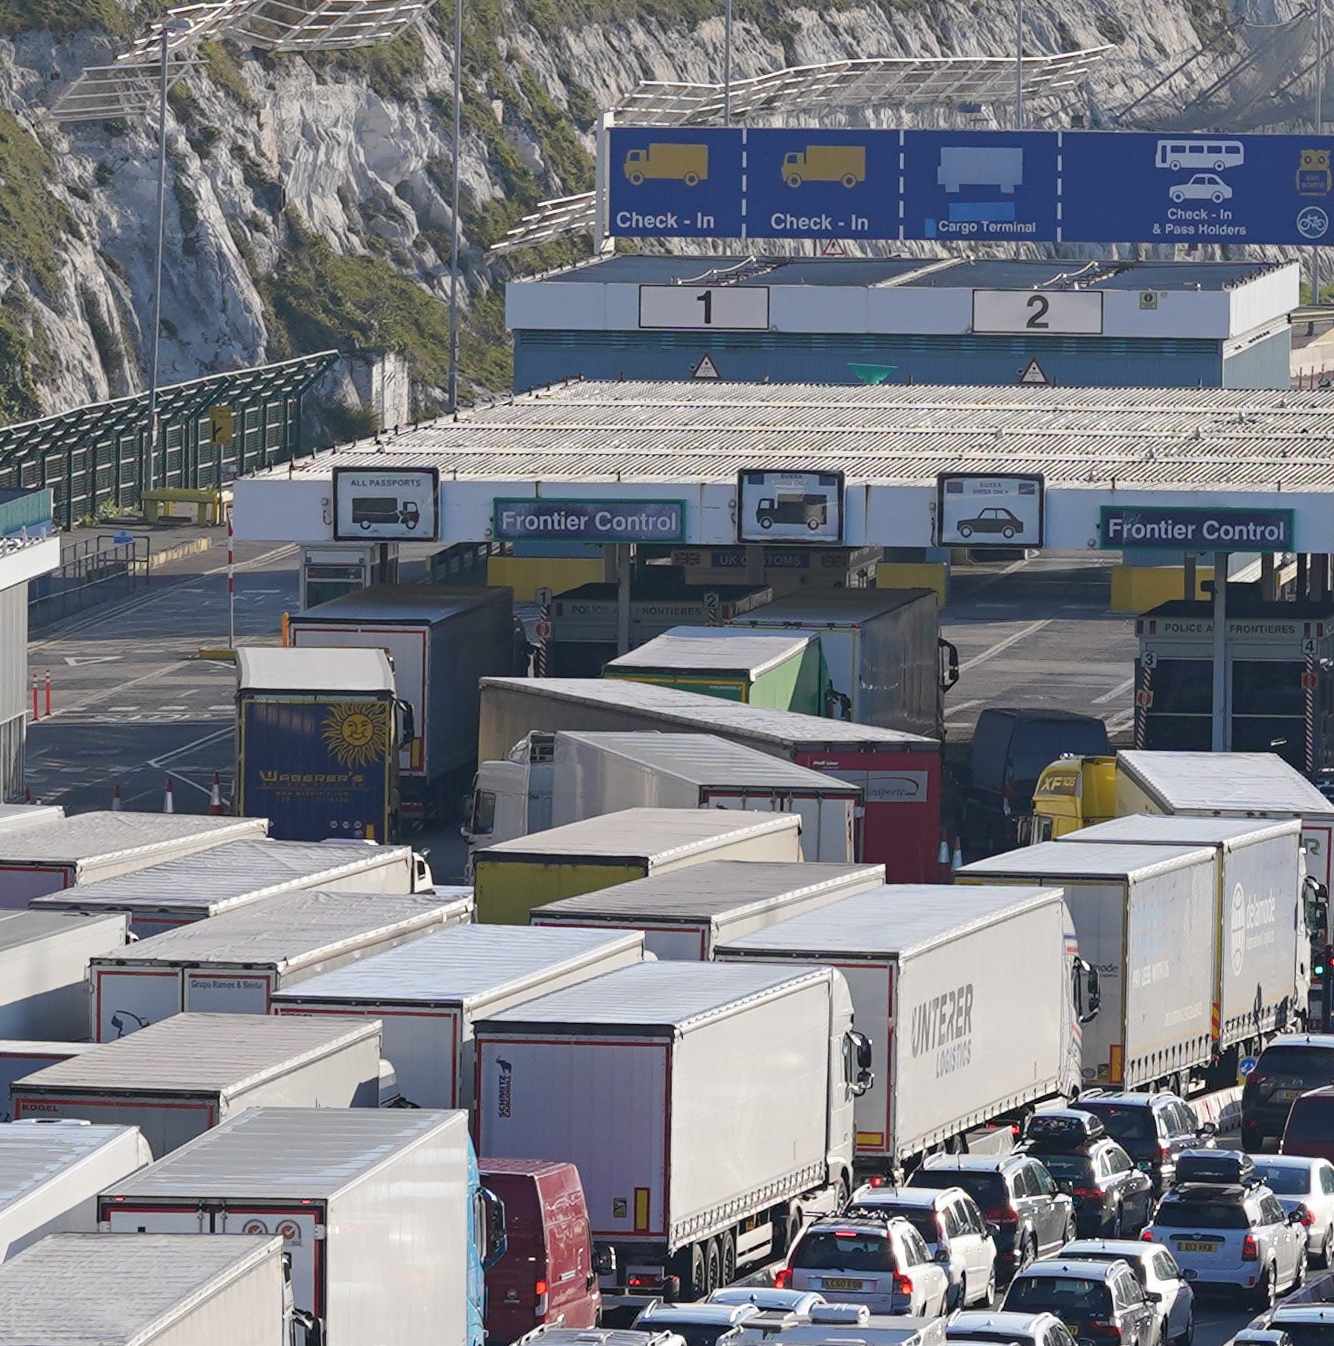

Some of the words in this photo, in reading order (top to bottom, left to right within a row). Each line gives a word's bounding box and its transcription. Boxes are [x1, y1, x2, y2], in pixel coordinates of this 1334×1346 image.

[616, 211, 679, 229] Check
[698, 211, 715, 229] In
[1167, 208, 1207, 220] Check
[1220, 208, 1232, 220] In
[771, 212, 832, 230] Check
[851, 213, 869, 231] In
[938, 219, 978, 233] Cargo
[981, 220, 1036, 233] Terminal
[1152, 224, 1163, 235] &
[1166, 224, 1196, 235] Pass
[1198, 224, 1247, 236] Holders
[696, 290, 712, 324] 1
[1026, 295, 1049, 328] 2
[350, 479, 367, 487] ALL
[369, 478, 421, 487] PASSPORTS
[502, 512, 589, 532] Frontier
[595, 511, 676, 532] Control
[1108, 519, 1196, 539] Frontier
[1203, 519, 1284, 541] Control
[719, 555, 737, 566] UK
[708, 595, 716, 607] 2
[1164, 623, 1203, 634] POLICE
[1229, 624, 1296, 634] FRONTIERES
[1304, 641, 1315, 653] 4
[1145, 653, 1154, 665] 3
[1041, 777, 1063, 791] XF
[935, 1038, 972, 1079] LOGISTICS
